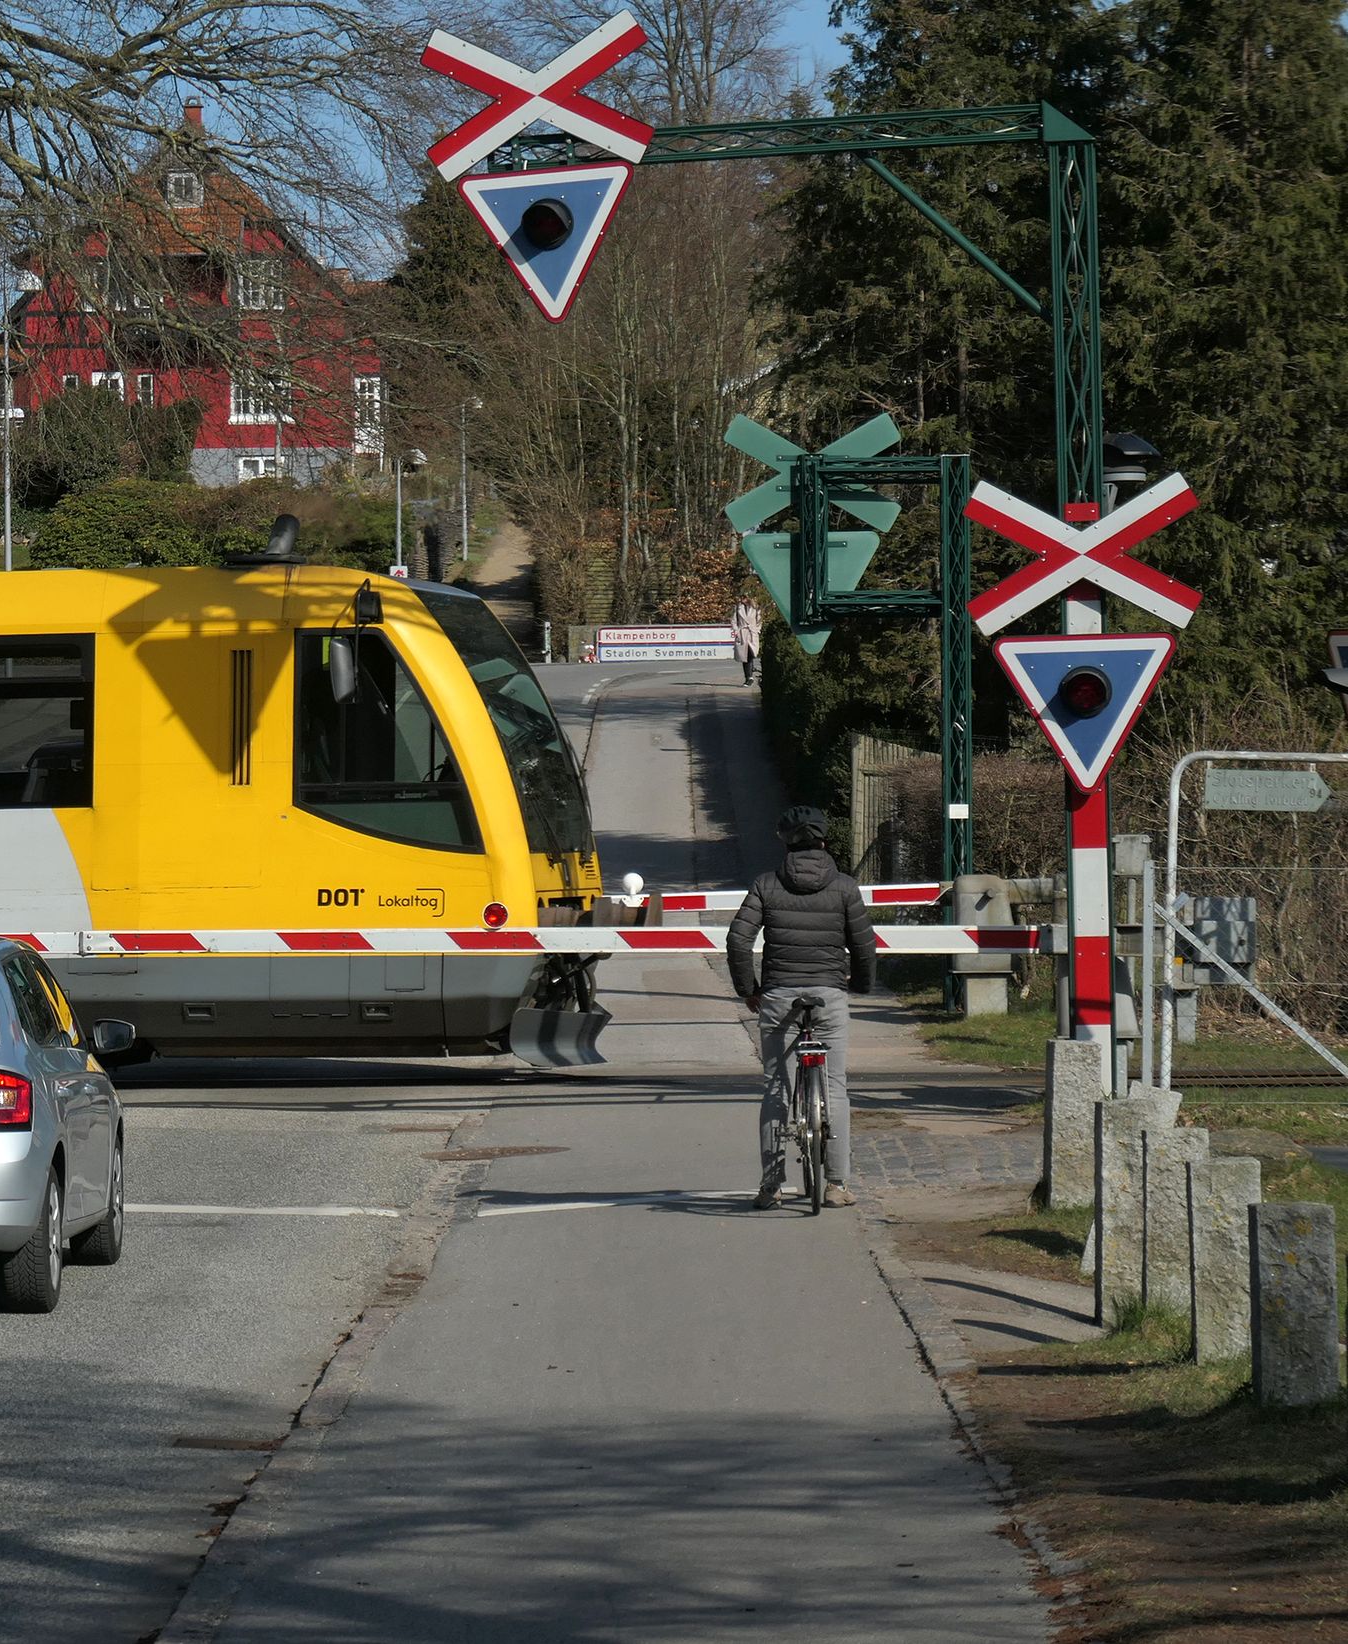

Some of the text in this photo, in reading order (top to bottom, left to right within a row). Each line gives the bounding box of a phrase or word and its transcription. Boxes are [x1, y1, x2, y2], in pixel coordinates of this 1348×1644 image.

[605, 632, 677, 641] Klampenborg
[605, 648, 717, 658] Stadion Svømmehal
[317, 888, 365, 907] DOT
[378, 895, 438, 911] Lokaltog
